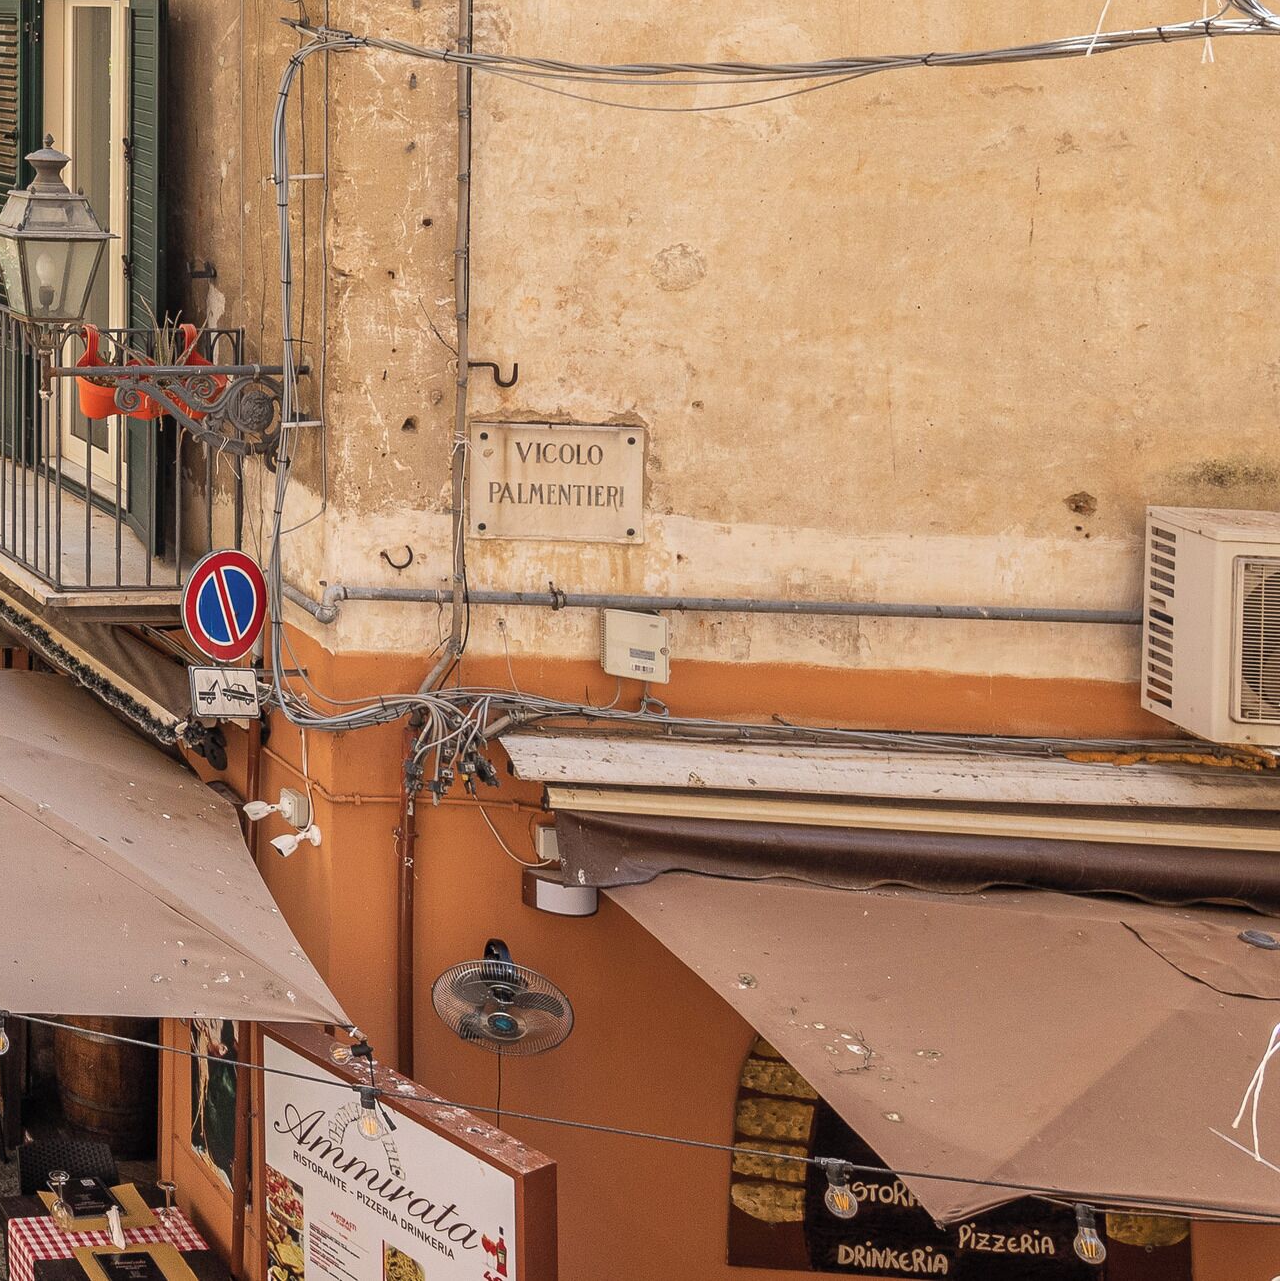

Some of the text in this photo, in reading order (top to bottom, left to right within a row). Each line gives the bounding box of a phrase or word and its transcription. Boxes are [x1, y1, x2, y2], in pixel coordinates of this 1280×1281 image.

[515, 442, 603, 465] VICOLO
[489, 482, 625, 512] PALMENTIERI
[274, 1103, 478, 1250] Ammirata
[293, 1150, 347, 1193] RISTORANTE
[356, 1190, 398, 1225] PIZZERIA
[400, 1218, 455, 1260] DRINKERIA
